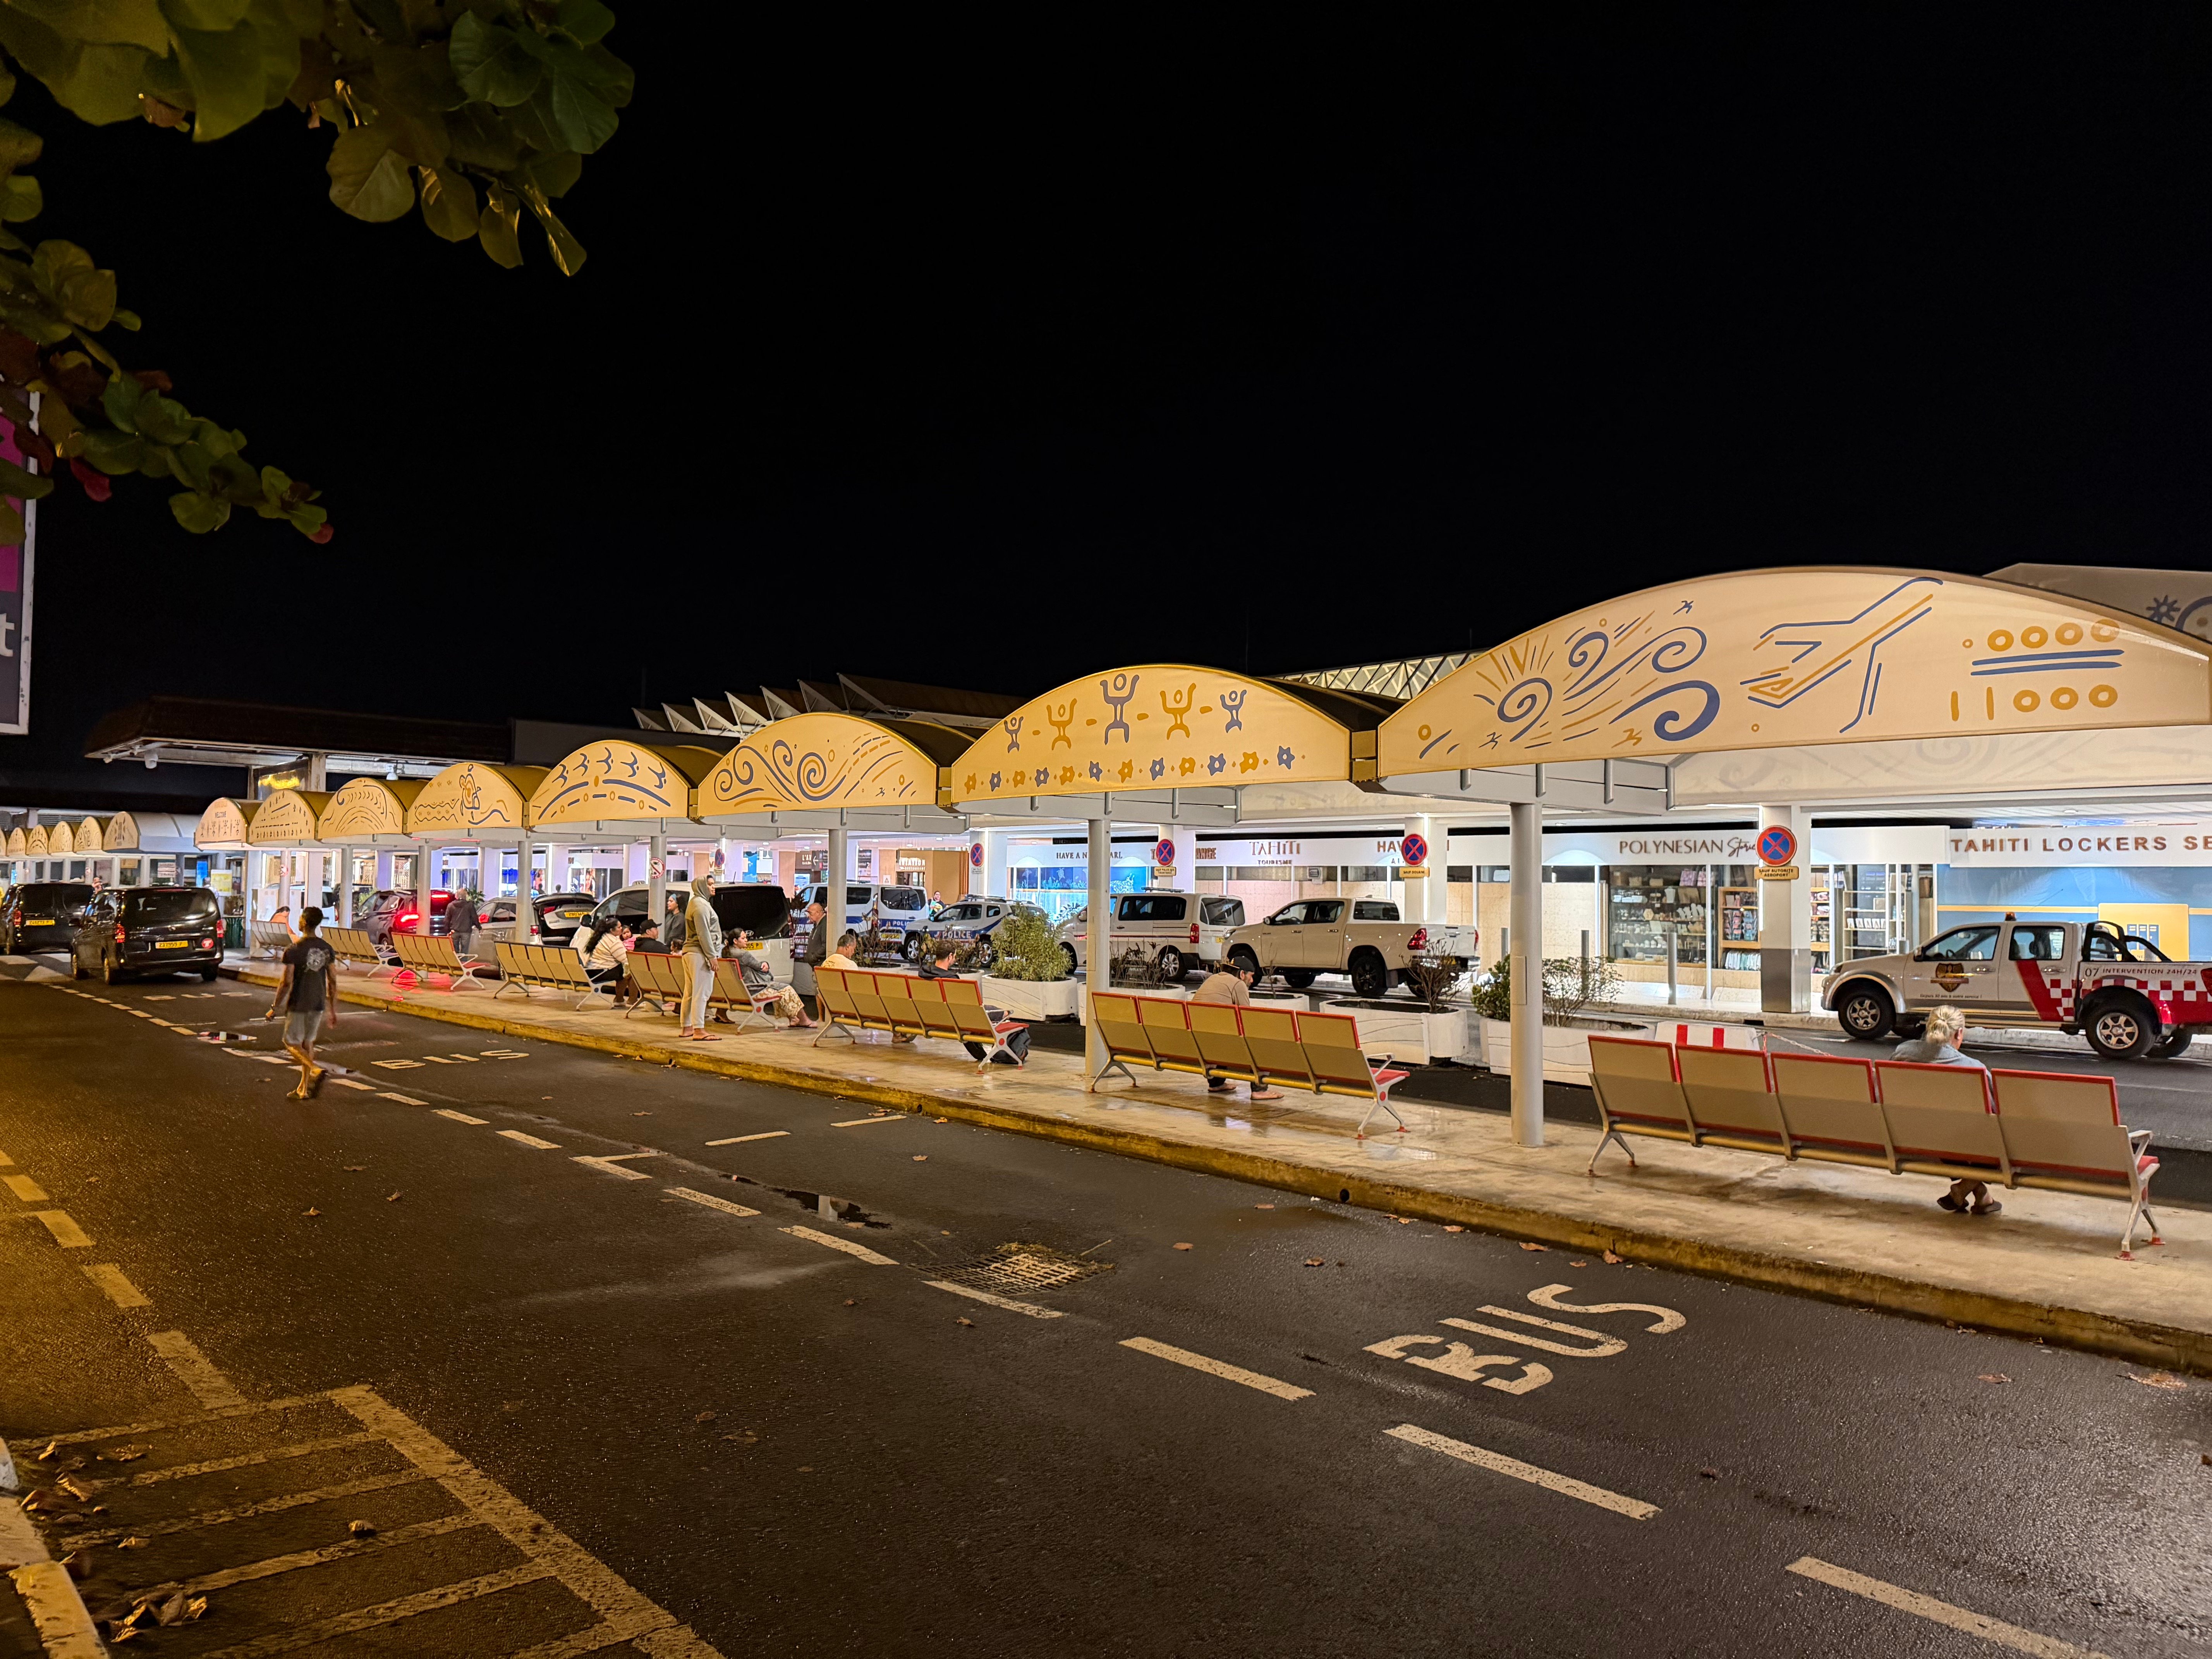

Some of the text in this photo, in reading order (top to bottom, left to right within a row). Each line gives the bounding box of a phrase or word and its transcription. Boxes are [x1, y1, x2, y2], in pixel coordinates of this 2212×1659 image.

[1619, 837, 1755, 857] POLYNESIAN Storie
[1951, 838, 2029, 852] TAHITI
[2043, 836, 2167, 852] LOCKERS
[1196, 848, 1216, 859] ANGE
[942, 930, 971, 939] POLICE
[2085, 968, 2099, 977] 07
[371, 1049, 529, 1069] BUS
[1362, 1283, 1687, 1395] BUS
